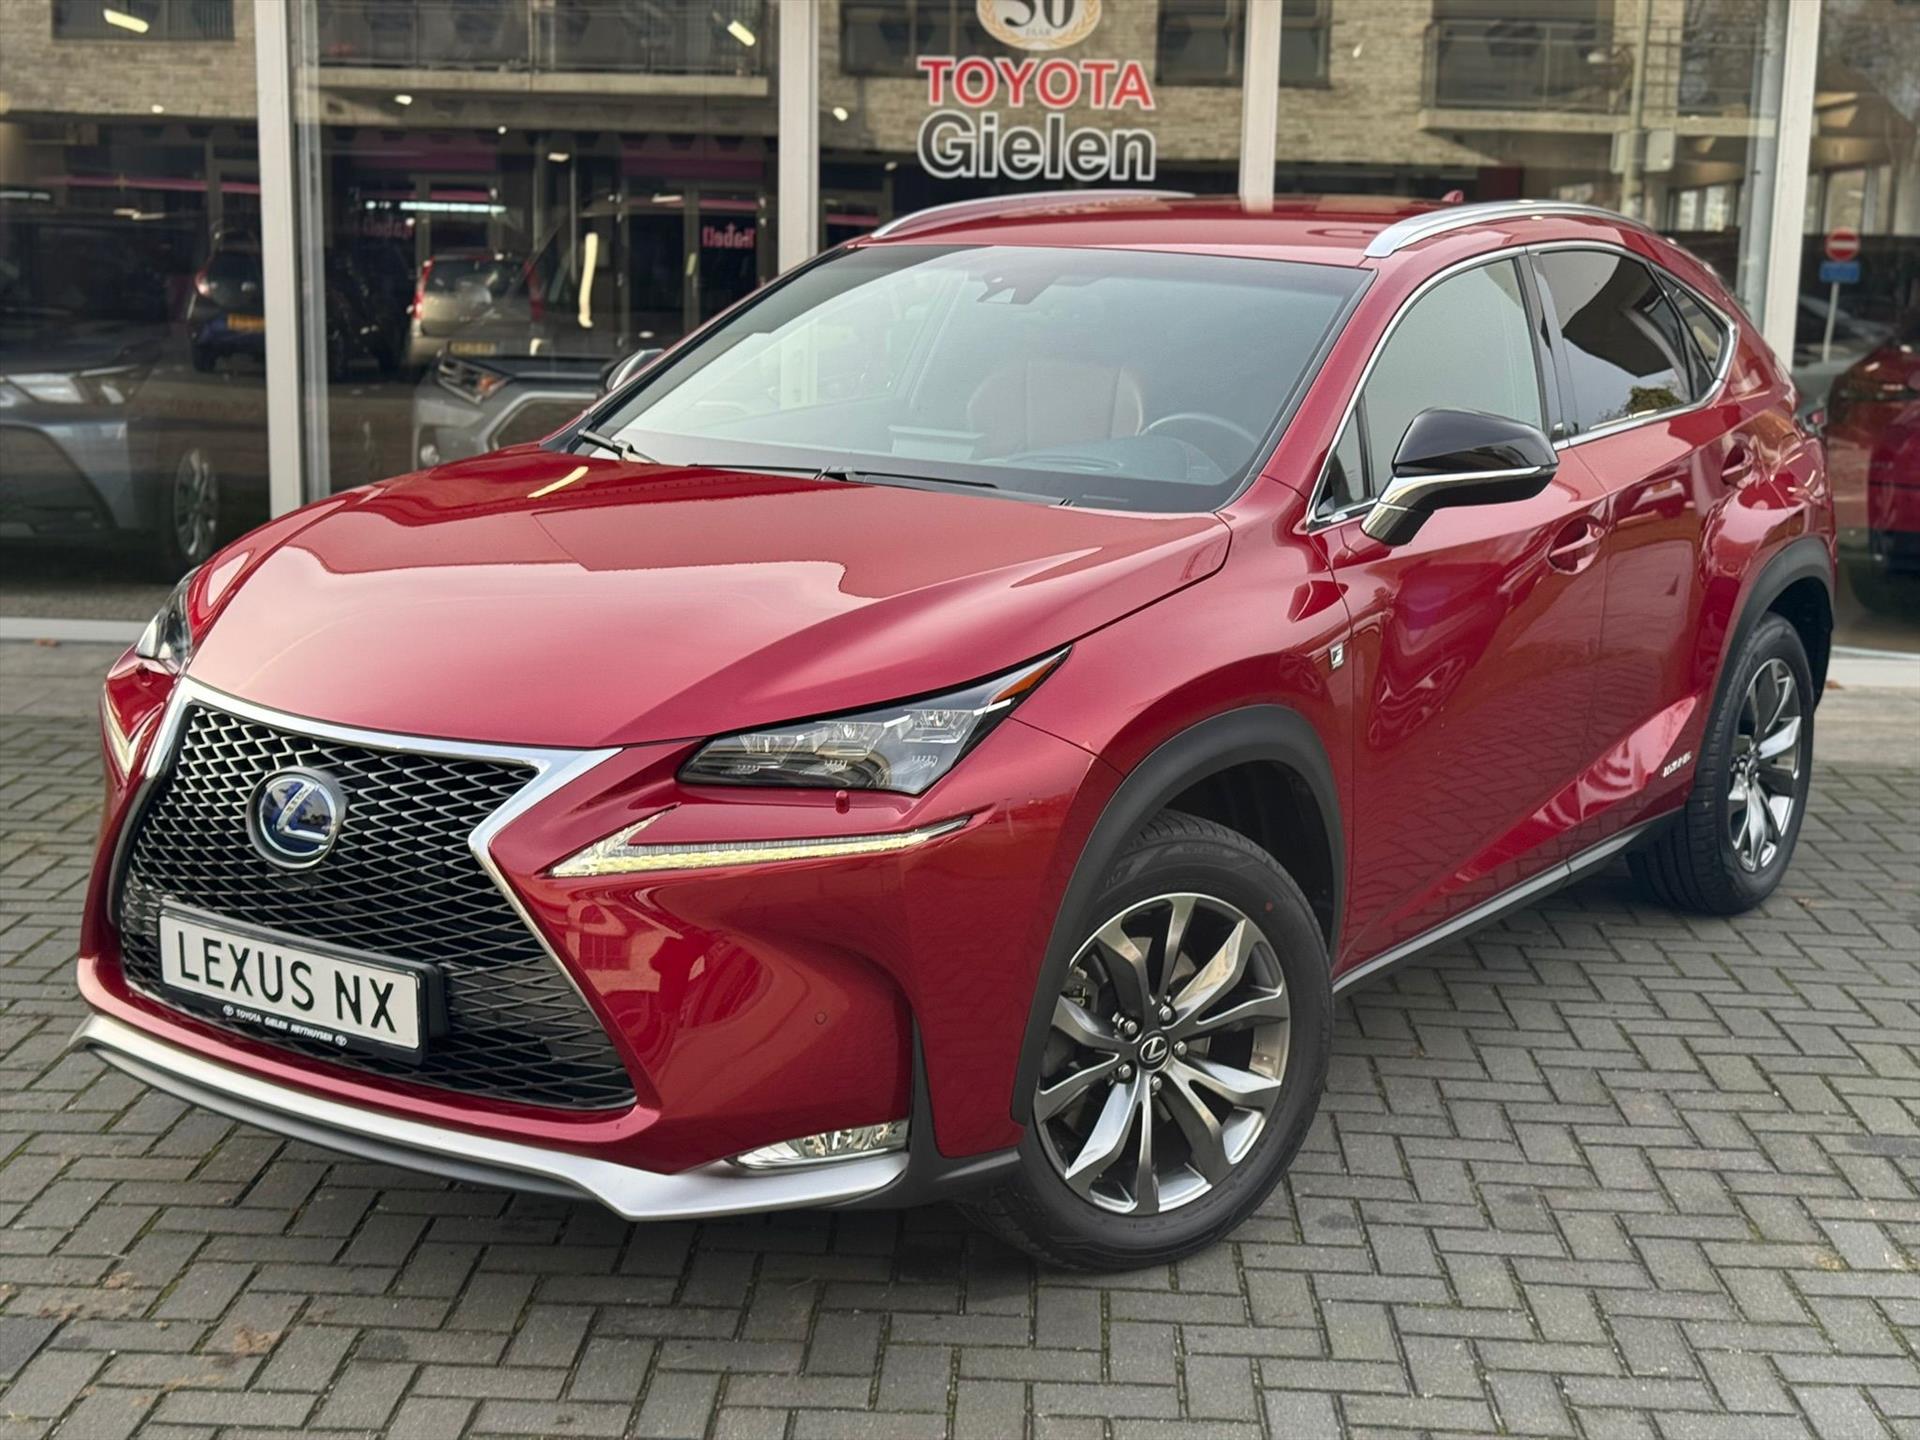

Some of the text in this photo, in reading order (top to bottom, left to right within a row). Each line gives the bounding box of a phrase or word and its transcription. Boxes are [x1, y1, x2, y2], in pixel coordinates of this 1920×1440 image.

[918, 56, 1156, 110] TOYOTA
[918, 109, 1157, 182] Gielen
[178, 931, 396, 1033] LEXUS NX
